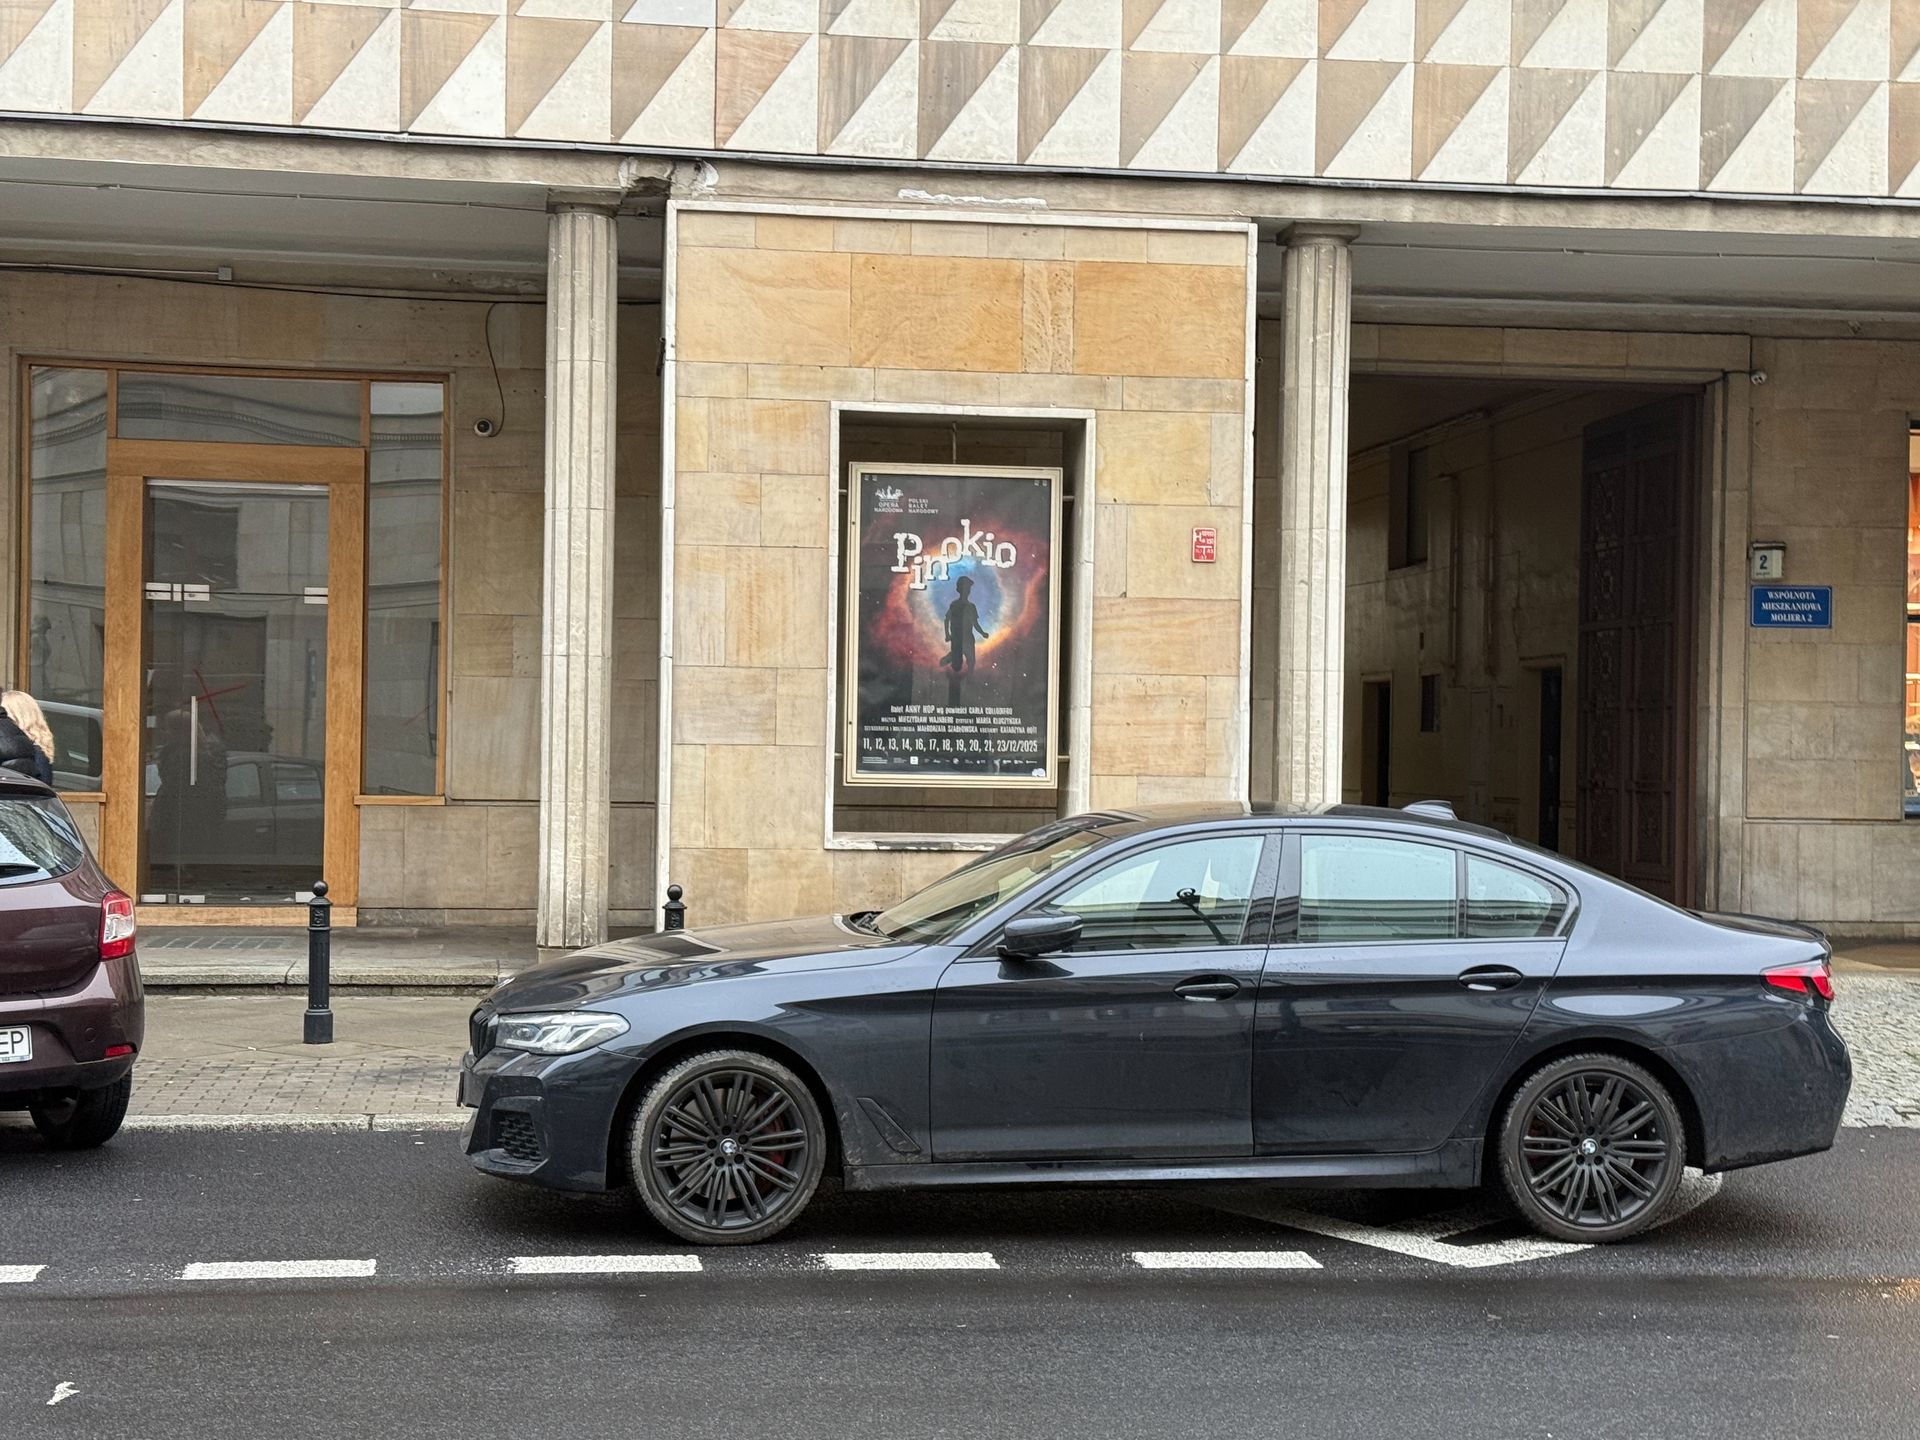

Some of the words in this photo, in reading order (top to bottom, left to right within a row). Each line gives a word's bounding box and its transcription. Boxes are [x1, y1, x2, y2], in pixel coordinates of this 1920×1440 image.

[890, 518, 1017, 591] Pinokio
[1759, 555, 1768, 570] 2
[1767, 590, 1816, 600] WSPÓLNOTA
[1761, 601, 1822, 612] MIESZKANIOWA
[1770, 613, 1806, 622] MOLIERA
[1807, 613, 1813, 622] 2
[863, 737, 872, 751] 11,
[875, 737, 885, 751] 12,
[888, 738, 899, 752] 13,
[902, 738, 913, 752] 14,
[915, 738, 926, 752] 16,
[929, 738, 940, 752] 17,
[942, 738, 953, 752] 18,
[955, 738, 967, 752] 19,
[969, 739, 982, 753] 20,
[984, 739, 995, 753] 21,
[996, 739, 1038, 753] 23/12/2025
